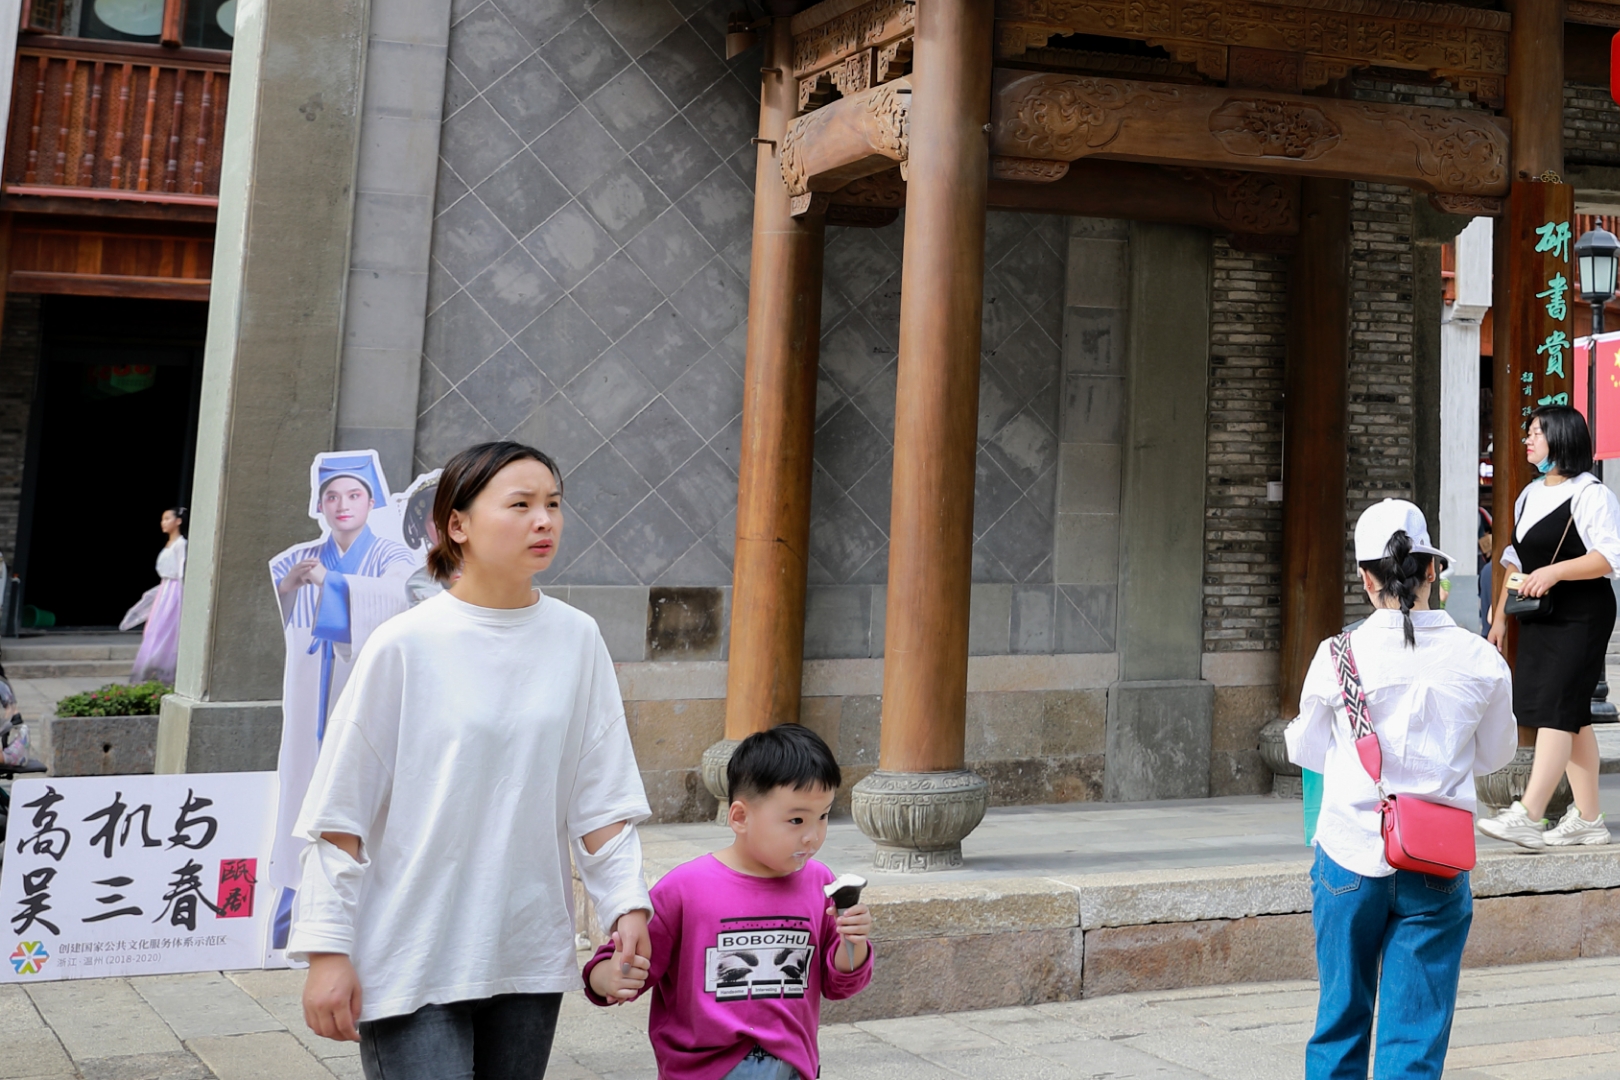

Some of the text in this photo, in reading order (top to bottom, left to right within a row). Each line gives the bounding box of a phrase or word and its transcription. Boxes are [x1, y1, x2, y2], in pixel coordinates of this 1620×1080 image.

[16, 785, 218, 862] 高机与
[11, 858, 227, 936] 吴三春
[58, 935, 228, 954] 创建国家公共文化服务体系示范区
[722, 934, 807, 947] BOBOZHU
